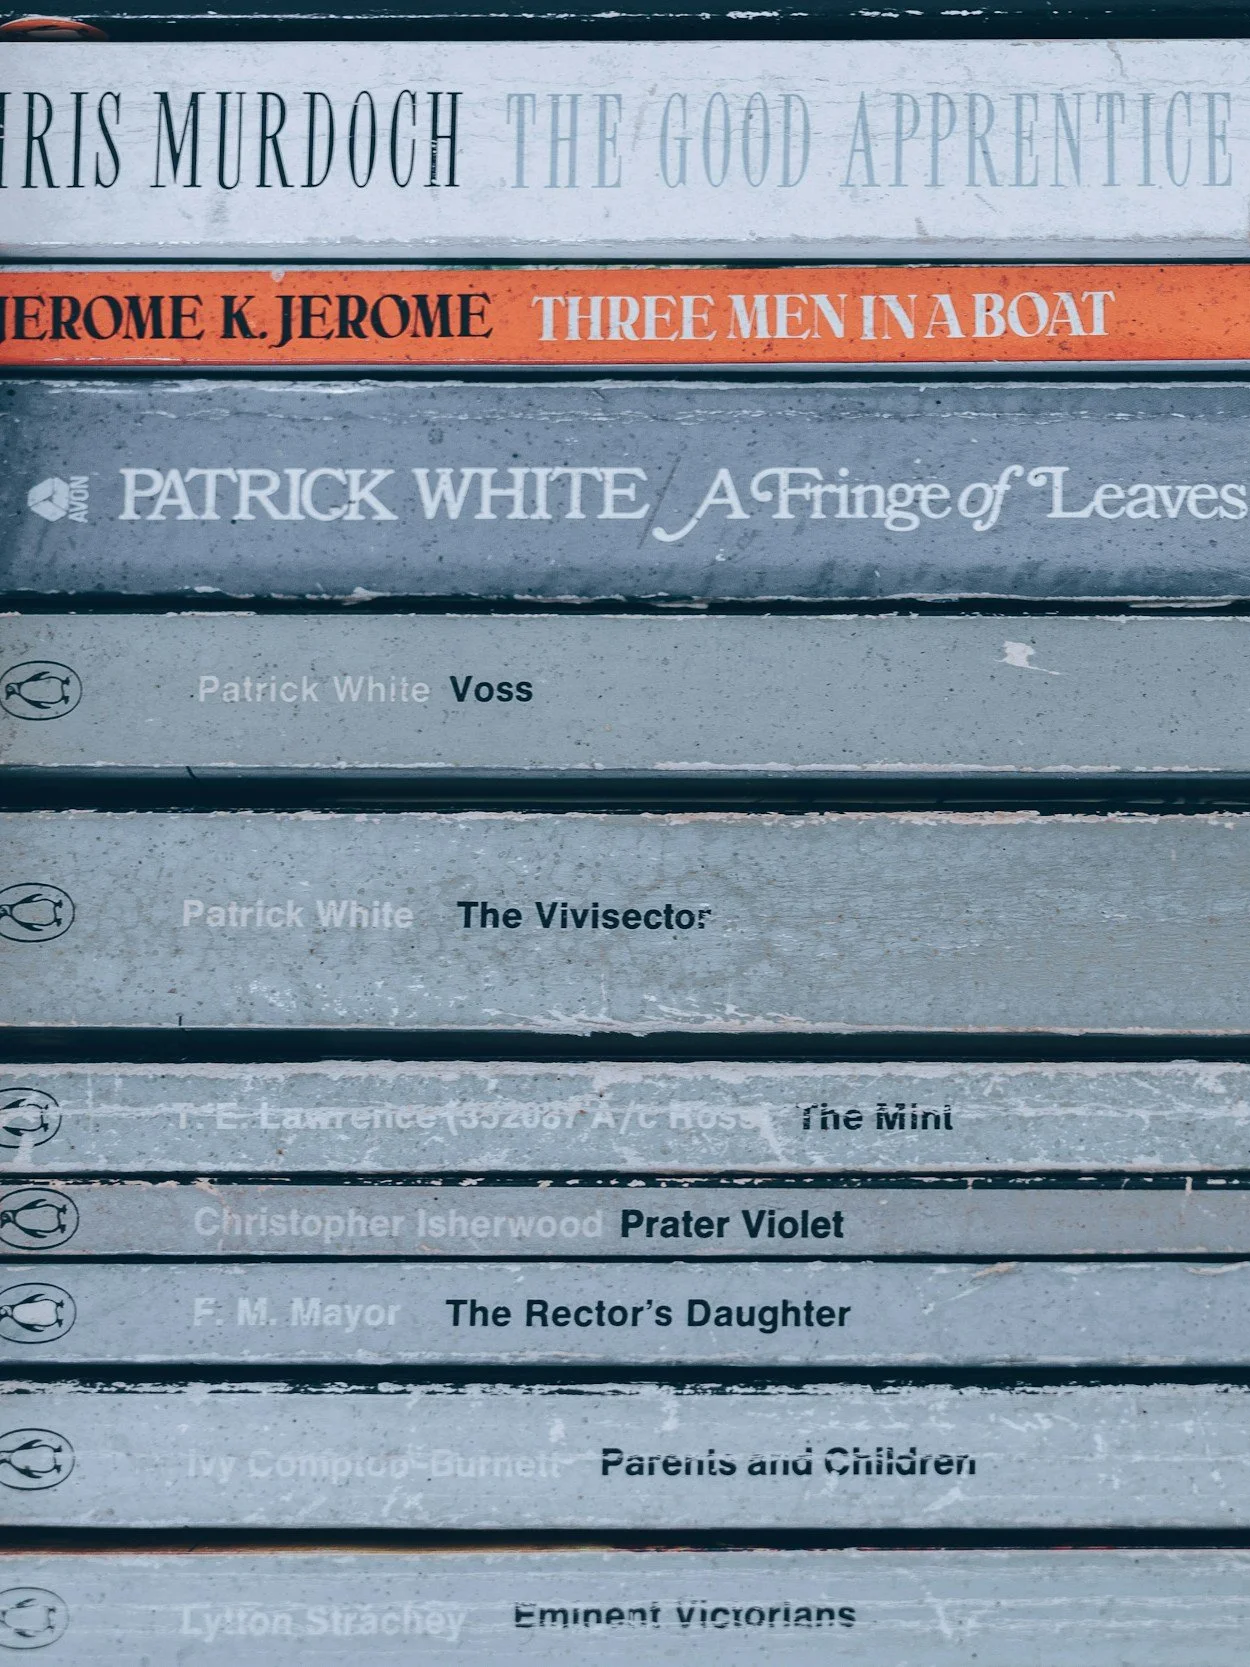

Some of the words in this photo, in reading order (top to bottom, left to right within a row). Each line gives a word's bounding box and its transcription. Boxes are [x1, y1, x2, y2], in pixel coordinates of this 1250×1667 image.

[150, 89, 463, 190] MURDOCH
[507, 93, 622, 188] THE
[659, 92, 812, 188] GOOD
[841, 91, 1233, 188] APPRENTICE
[219, 295, 268, 340] K.
[268, 292, 493, 349] JEROME
[532, 294, 717, 342] THREE
[727, 293, 848, 340] MEN
[860, 294, 917, 340] IN
[923, 293, 966, 339] A
[972, 290, 1116, 338] BOAT
[69, 475, 89, 523] AVON
[118, 467, 399, 522] PATRICK
[411, 466, 650, 520] WHITE
[652, 467, 751, 543] A
[750, 467, 952, 532] Fringe
[957, 464, 1025, 532] of
[1026, 466, 1248, 520] Leaves
[199, 675, 319, 704] Patrick
[334, 677, 430, 704] White
[449, 675, 533, 703] Voss
[183, 900, 304, 929] Patrick
[316, 901, 414, 929] White
[456, 900, 523, 929] The
[535, 901, 712, 930] Vivisector
[260, 1102, 436, 1131] Lawrence
[800, 1103, 863, 1130] The
[876, 1104, 953, 1131] Mint
[194, 1207, 403, 1242] Christopher
[418, 1209, 601, 1238] Isherwood
[621, 1209, 730, 1239] Prater
[741, 1209, 845, 1239] Violet
[237, 1298, 277, 1326] M.
[291, 1298, 401, 1333] Mayor
[445, 1298, 512, 1327] The
[687, 1298, 852, 1335] Daughter
[188, 1449, 235, 1483] Ivy
[601, 1447, 737, 1477] Parents
[747, 1447, 813, 1476] and
[824, 1446, 976, 1476] Children
[306, 1601, 467, 1641] Strachey
[515, 1601, 661, 1628] Eminent
[676, 1600, 856, 1628] Victorians
